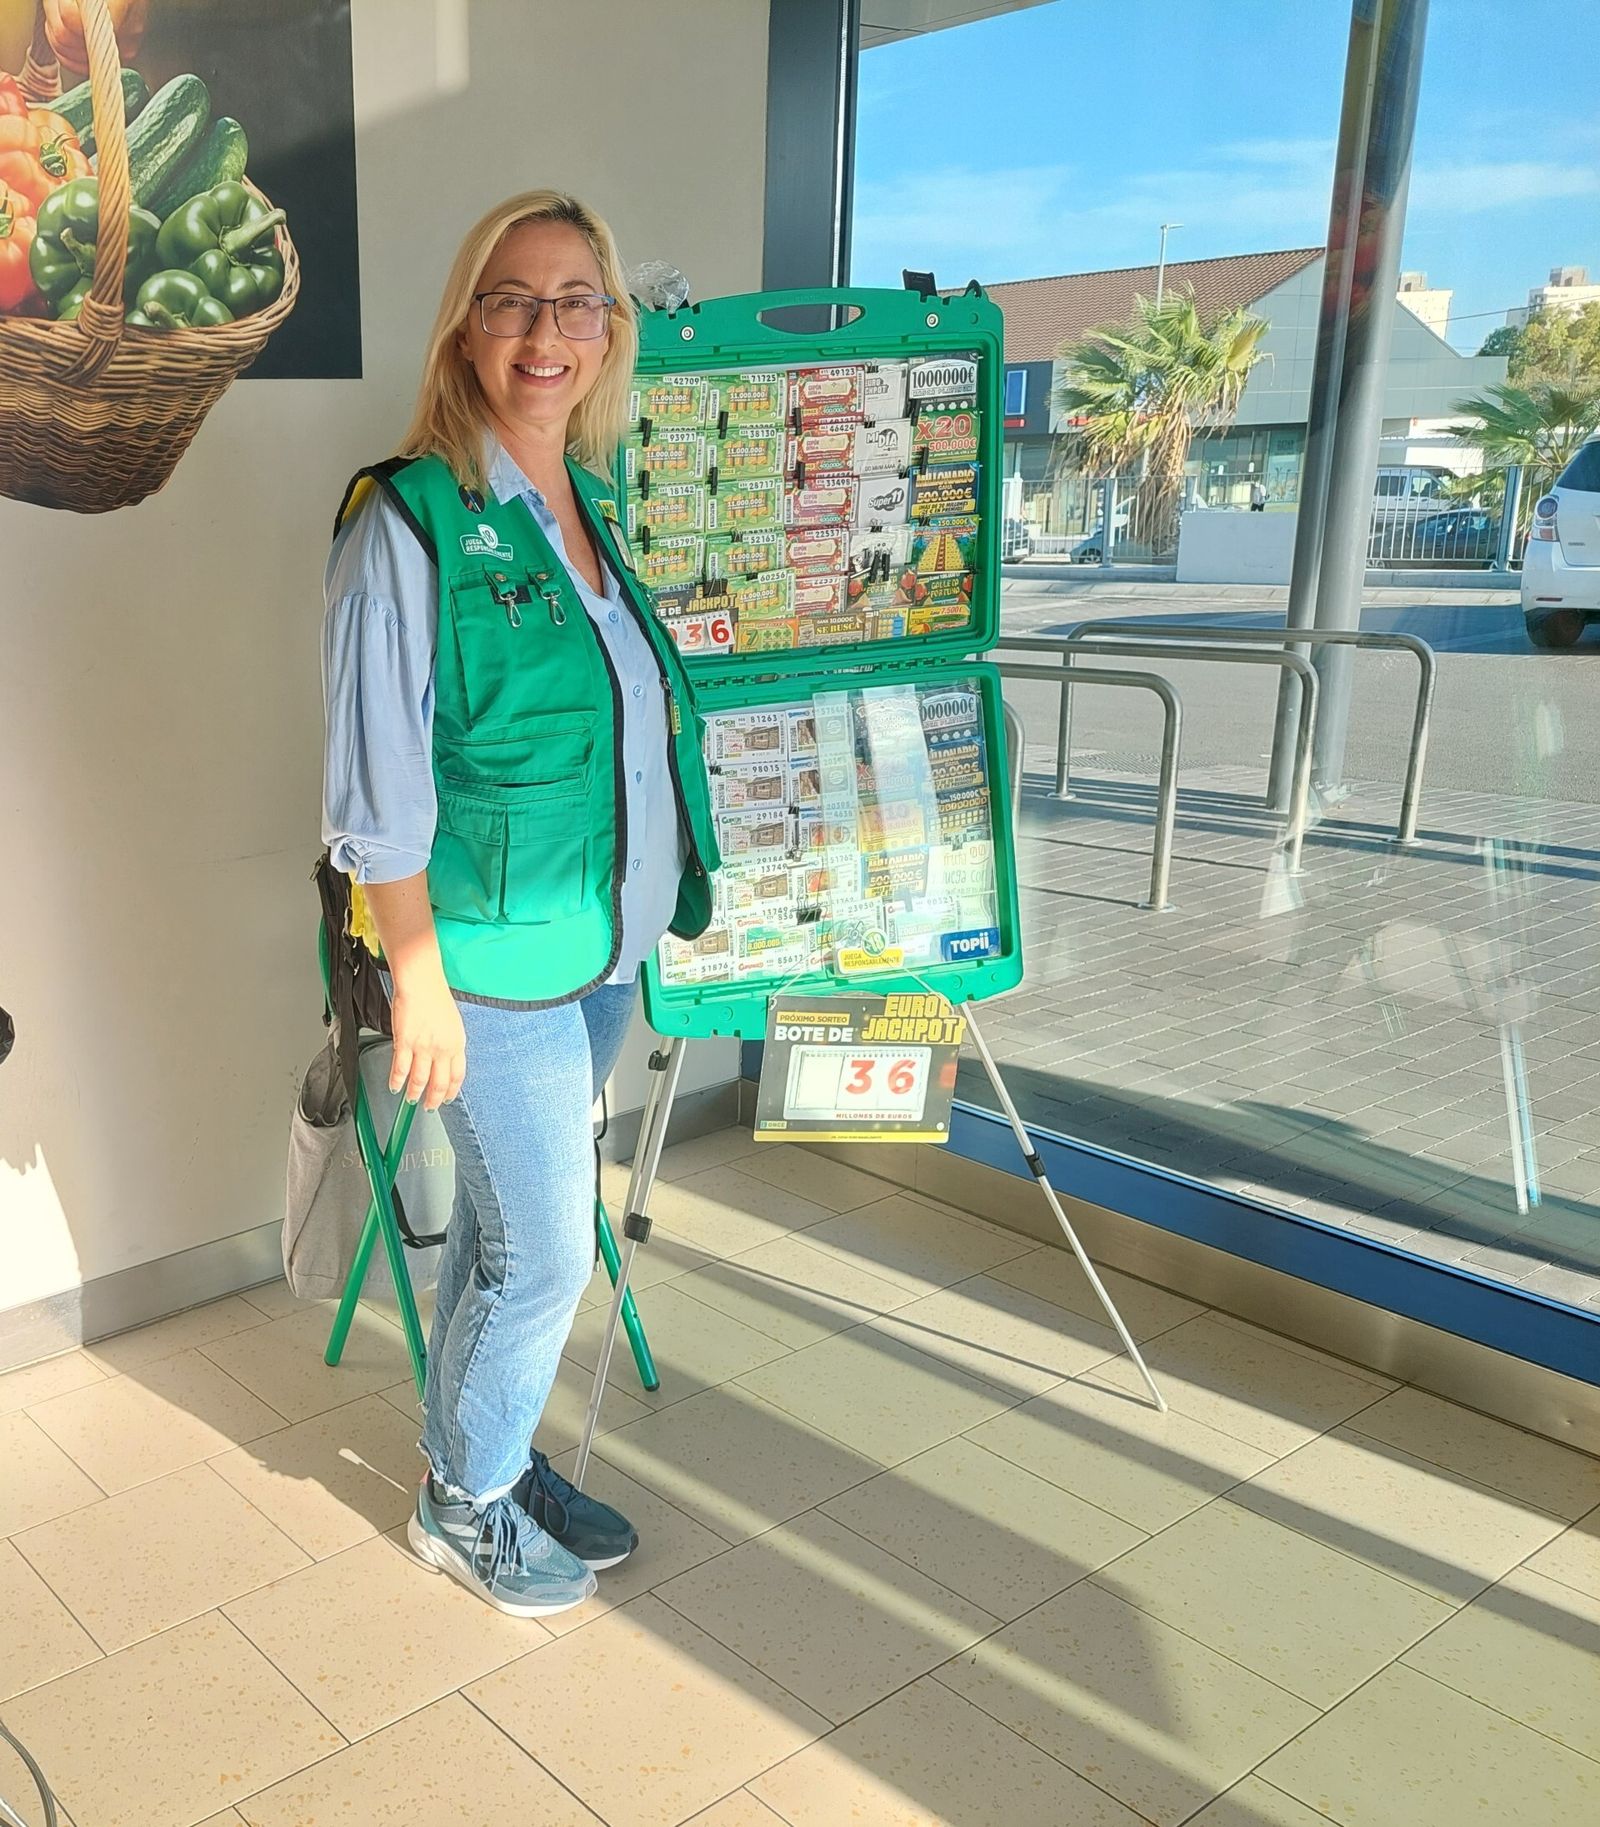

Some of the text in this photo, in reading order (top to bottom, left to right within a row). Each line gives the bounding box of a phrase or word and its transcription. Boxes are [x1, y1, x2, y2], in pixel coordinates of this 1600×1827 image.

[830, 368, 855, 377] 49123
[673, 378, 700, 386] 42709
[751, 374, 776, 383] 71725
[865, 378, 884, 386] URO
[912, 367, 975, 389] 1000000€
[829, 423, 854, 432] 46424
[669, 433, 696, 442] 93971
[750, 430, 775, 438] 38130
[928, 438, 976, 451] 500.000€
[826, 478, 851, 487] 33498
[916, 470, 975, 487] MILLONARIO
[669, 486, 695, 495] 18142
[749, 481, 774, 491] 28717
[918, 487, 973, 502] 500.000€
[868, 497, 892, 510] Super
[815, 529, 840, 539] 22537
[670, 536, 696, 548] 85798
[750, 535, 775, 545] 52163
[760, 571, 786, 582] 60256
[686, 594, 737, 612] JACKPOT
[668, 606, 682, 616] DE
[816, 622, 861, 635] SE BUSCA
[921, 697, 975, 721] 000000€
[750, 714, 778, 724] 81263
[752, 764, 780, 774] 98015
[756, 811, 783, 821] 29184
[756, 856, 784, 866] 29184
[761, 863, 788, 873] 13749
[848, 902, 874, 914] 23950
[701, 962, 728, 973] 51876
[886, 996, 939, 1018] EURO
[780, 1013, 848, 1023] PRÓXIMO SORTEO
[774, 1025, 854, 1042] BOTE DE
[861, 1017, 960, 1042] JACKPOT
